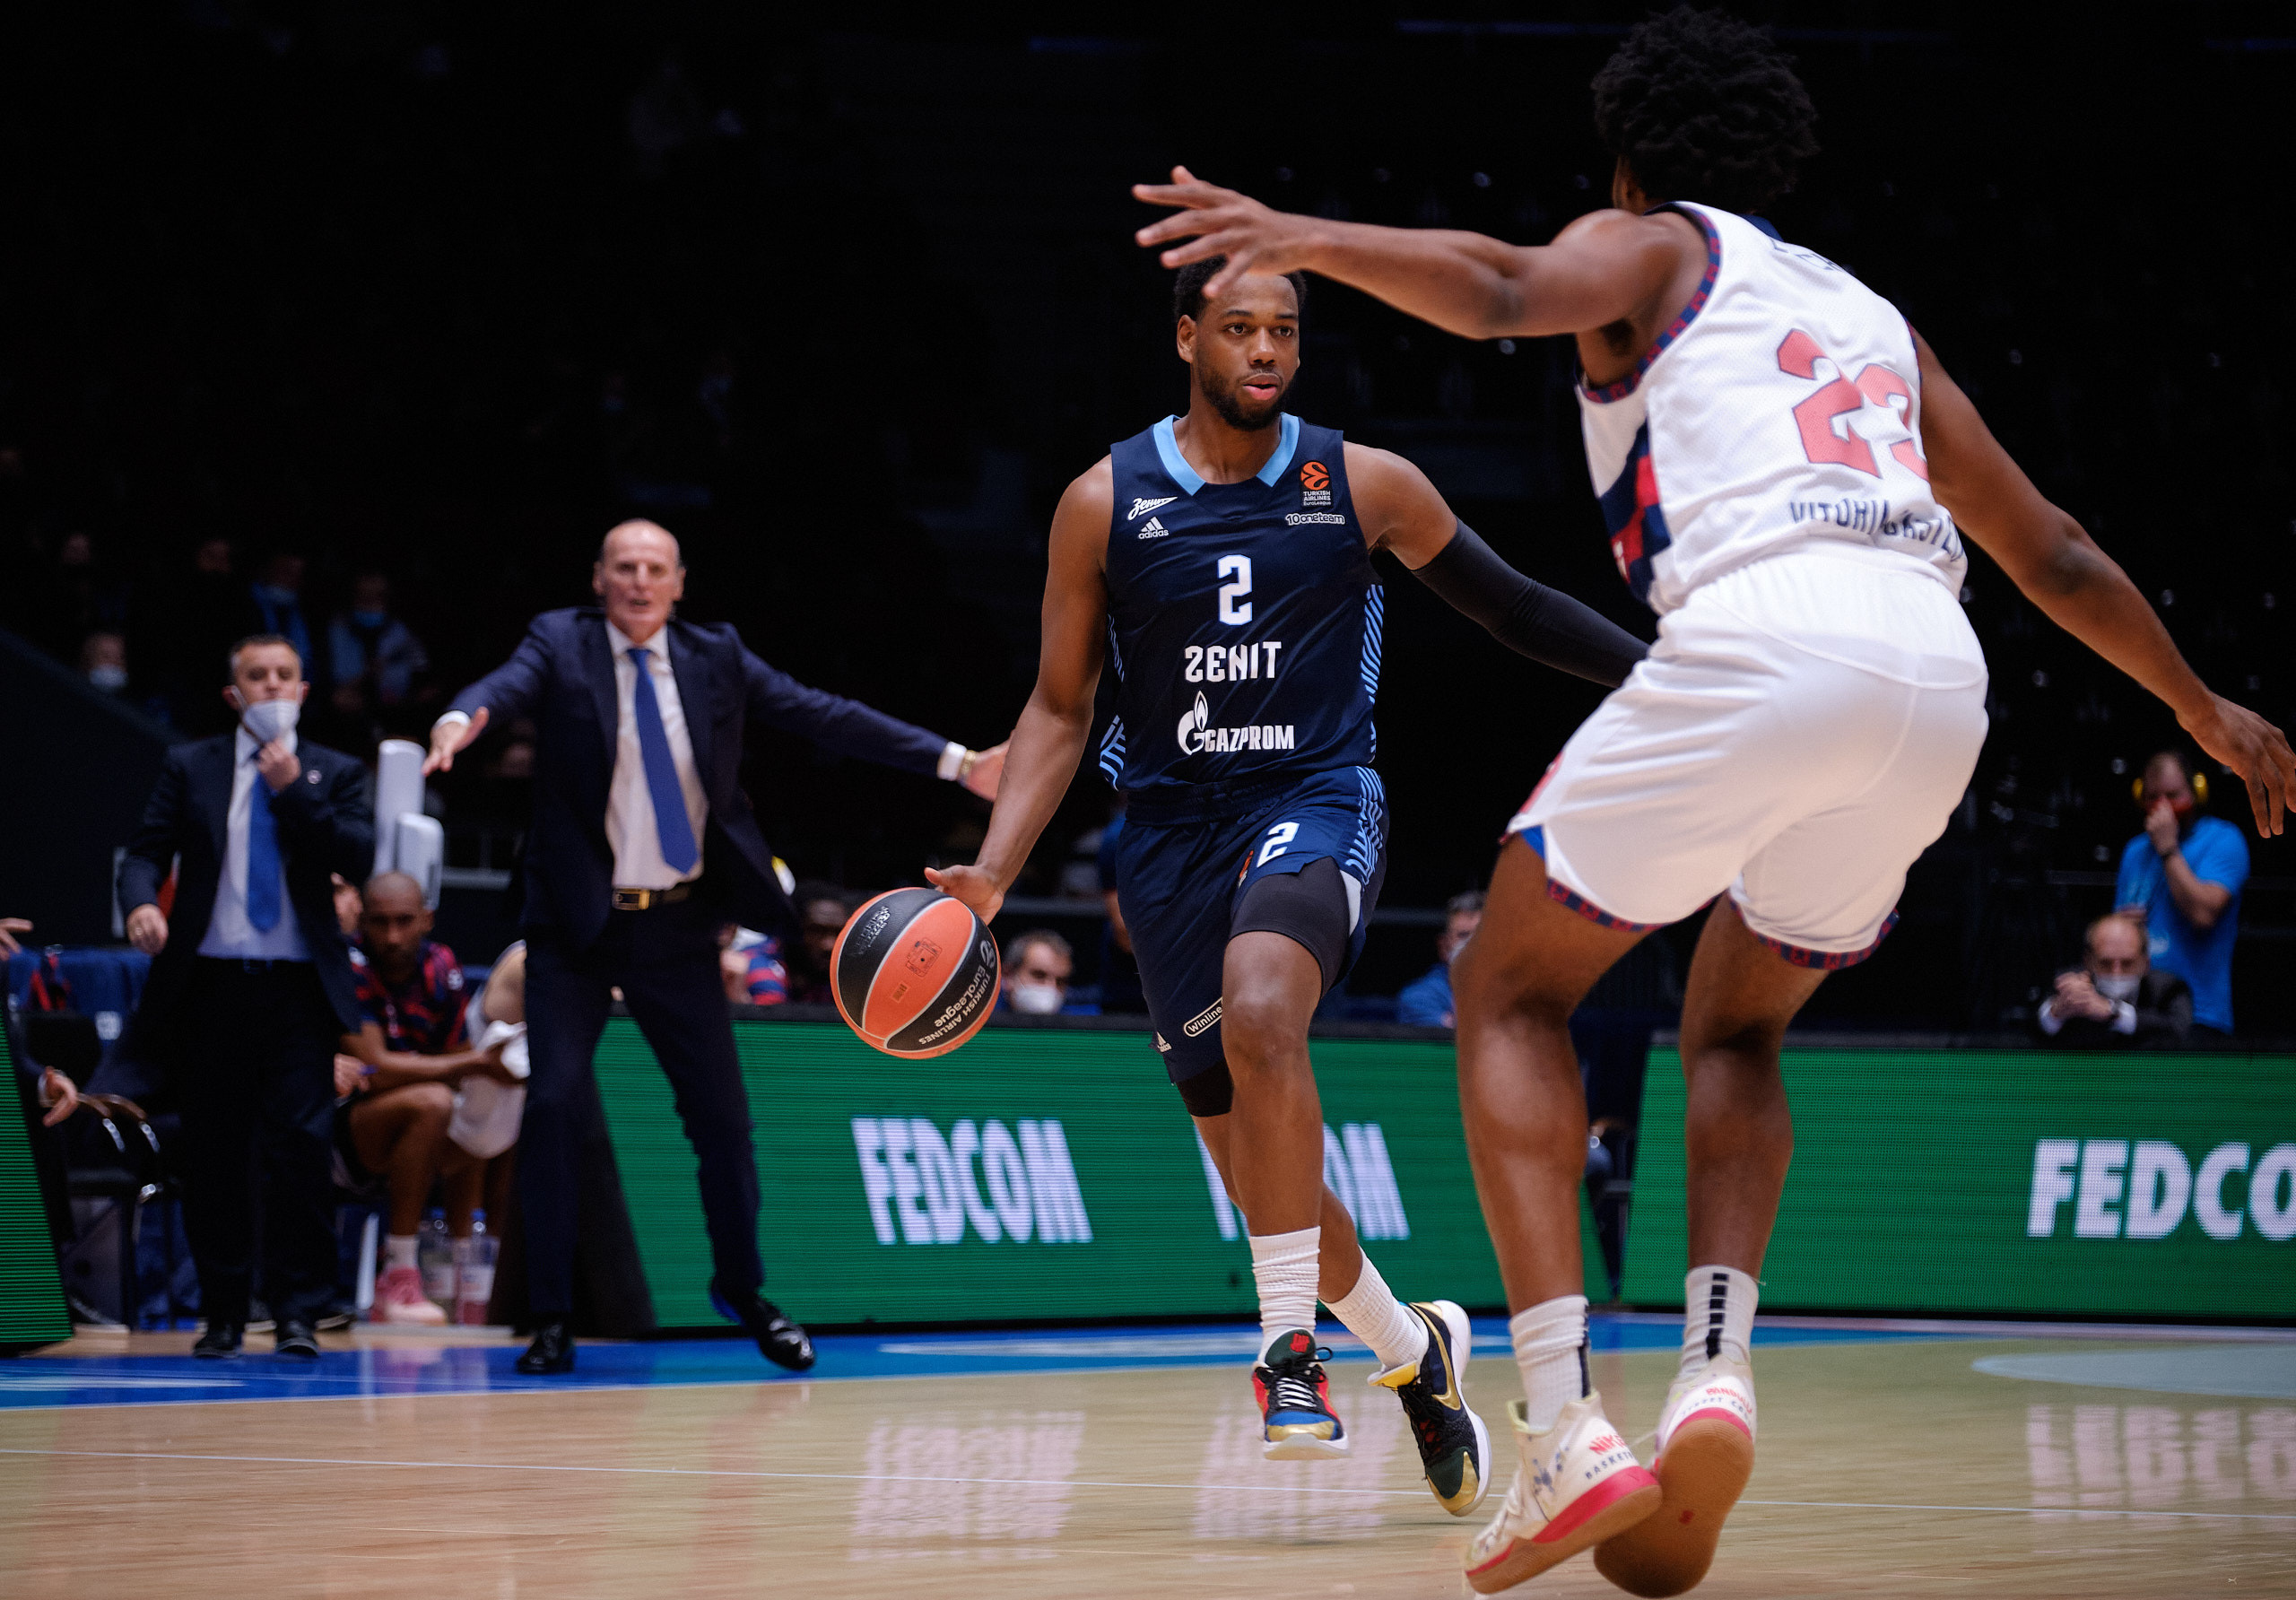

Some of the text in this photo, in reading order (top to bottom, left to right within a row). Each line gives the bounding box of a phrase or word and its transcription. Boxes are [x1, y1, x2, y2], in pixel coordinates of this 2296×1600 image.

[1776, 327, 1929, 483] 23
[1138, 528, 1170, 540] adidas
[1217, 553, 1253, 626] 2
[1184, 640, 1283, 683] ZENIT
[1204, 724, 1295, 752] GAZPROM
[1257, 821, 1300, 868] 2
[918, 972, 991, 1045] TURKISH AIRLINES
[934, 964, 986, 1028] EuroLeague
[1187, 1006, 1223, 1033] Winline
[850, 1116, 1093, 1244] FEDCOM
[2026, 1138, 2296, 1241] FEDCO
